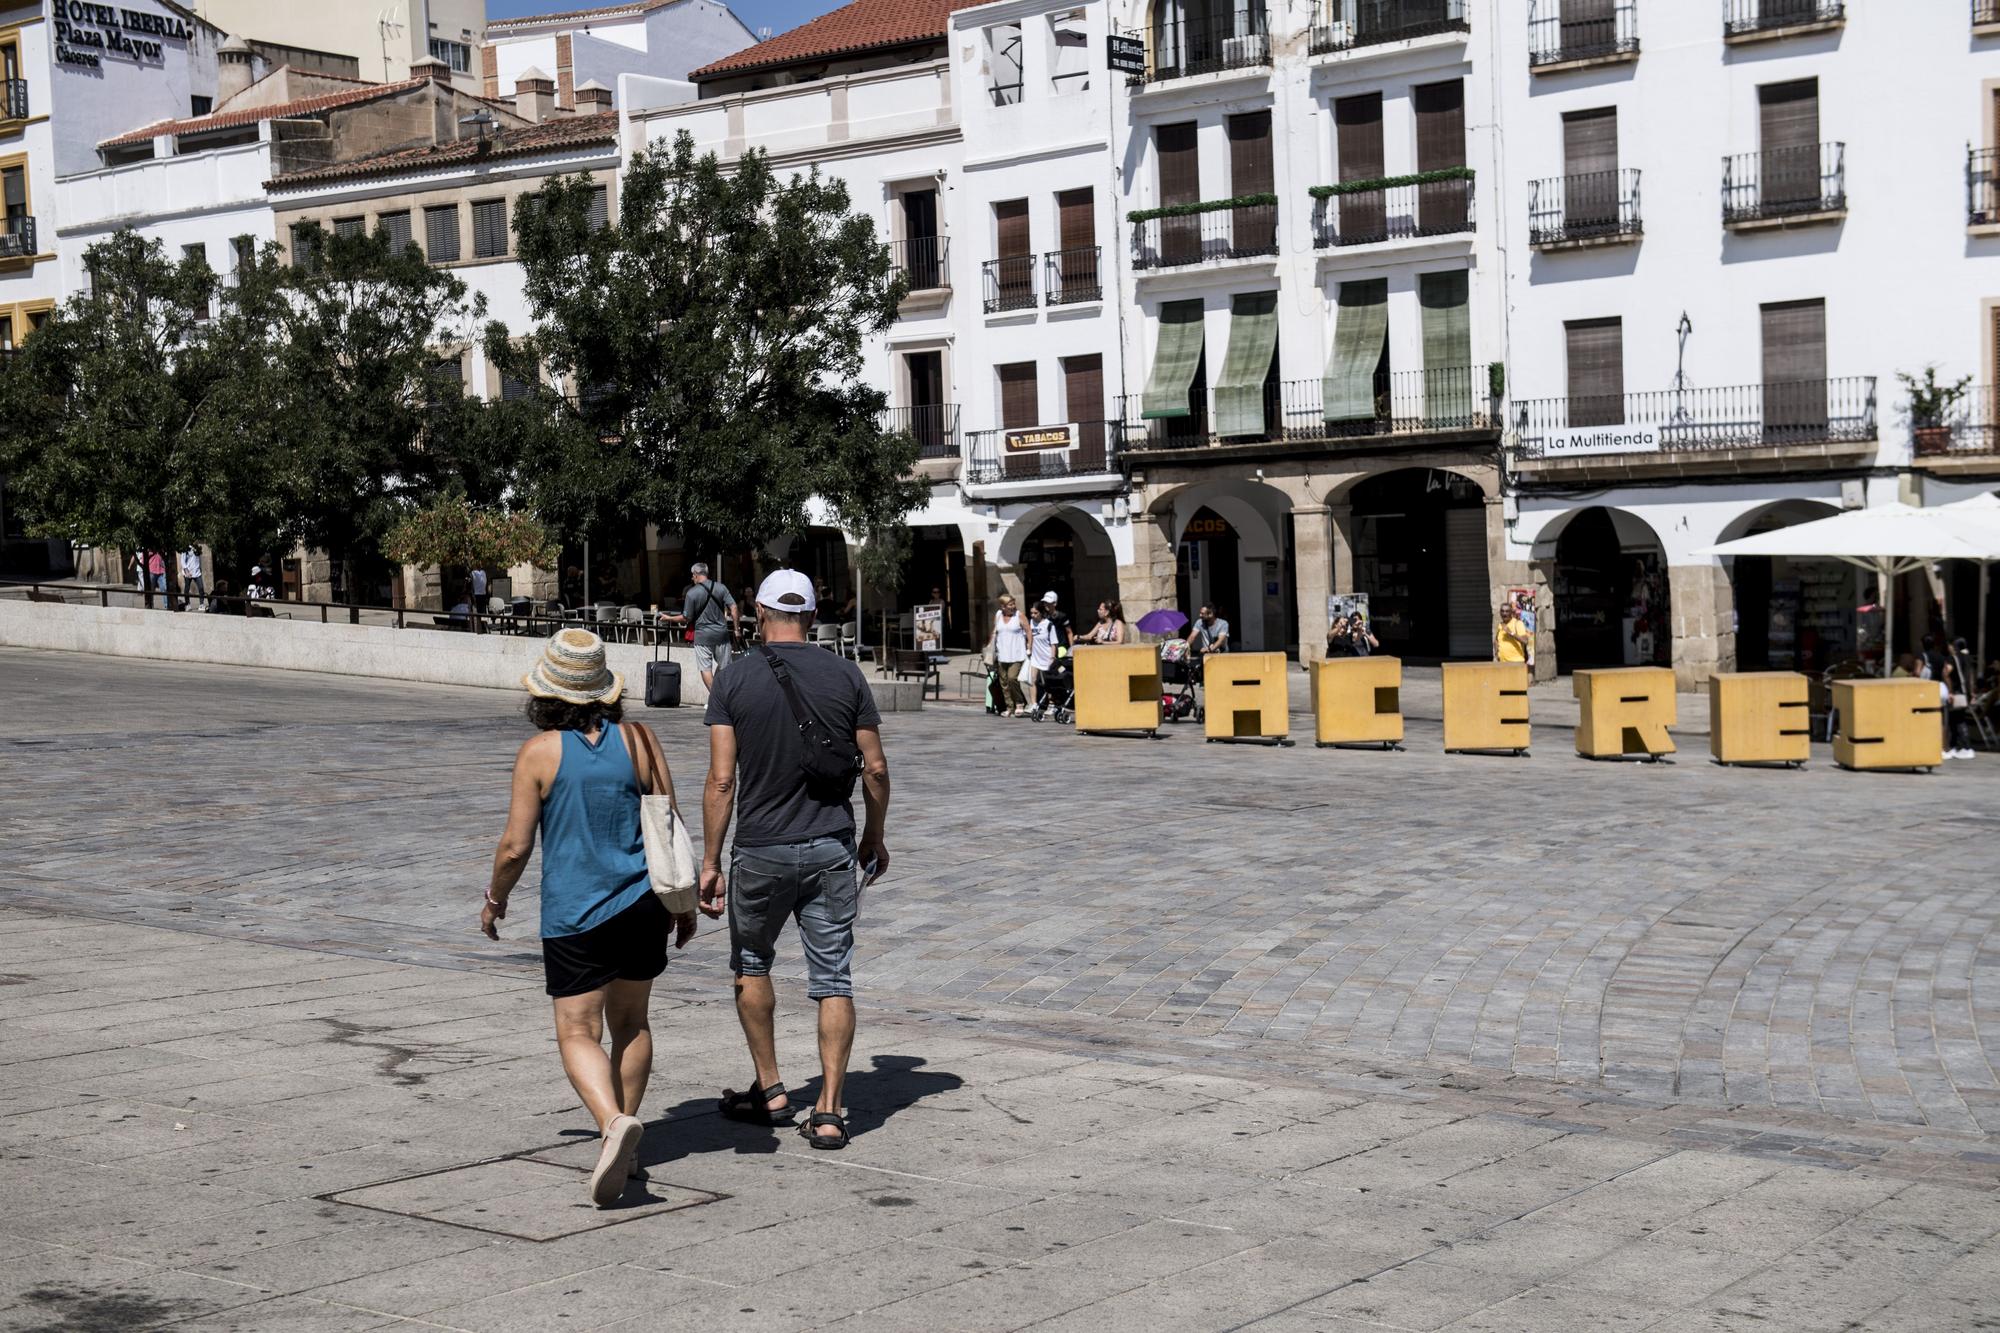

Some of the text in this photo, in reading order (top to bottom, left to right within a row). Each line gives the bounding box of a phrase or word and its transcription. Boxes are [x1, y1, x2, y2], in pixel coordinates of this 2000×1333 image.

[54, 0, 187, 40] HOTEL IBERIA
[54, 21, 161, 60] Plaza Mayor
[1022, 431, 1065, 444] TABACOS
[1549, 431, 1653, 449] La Multitienda
